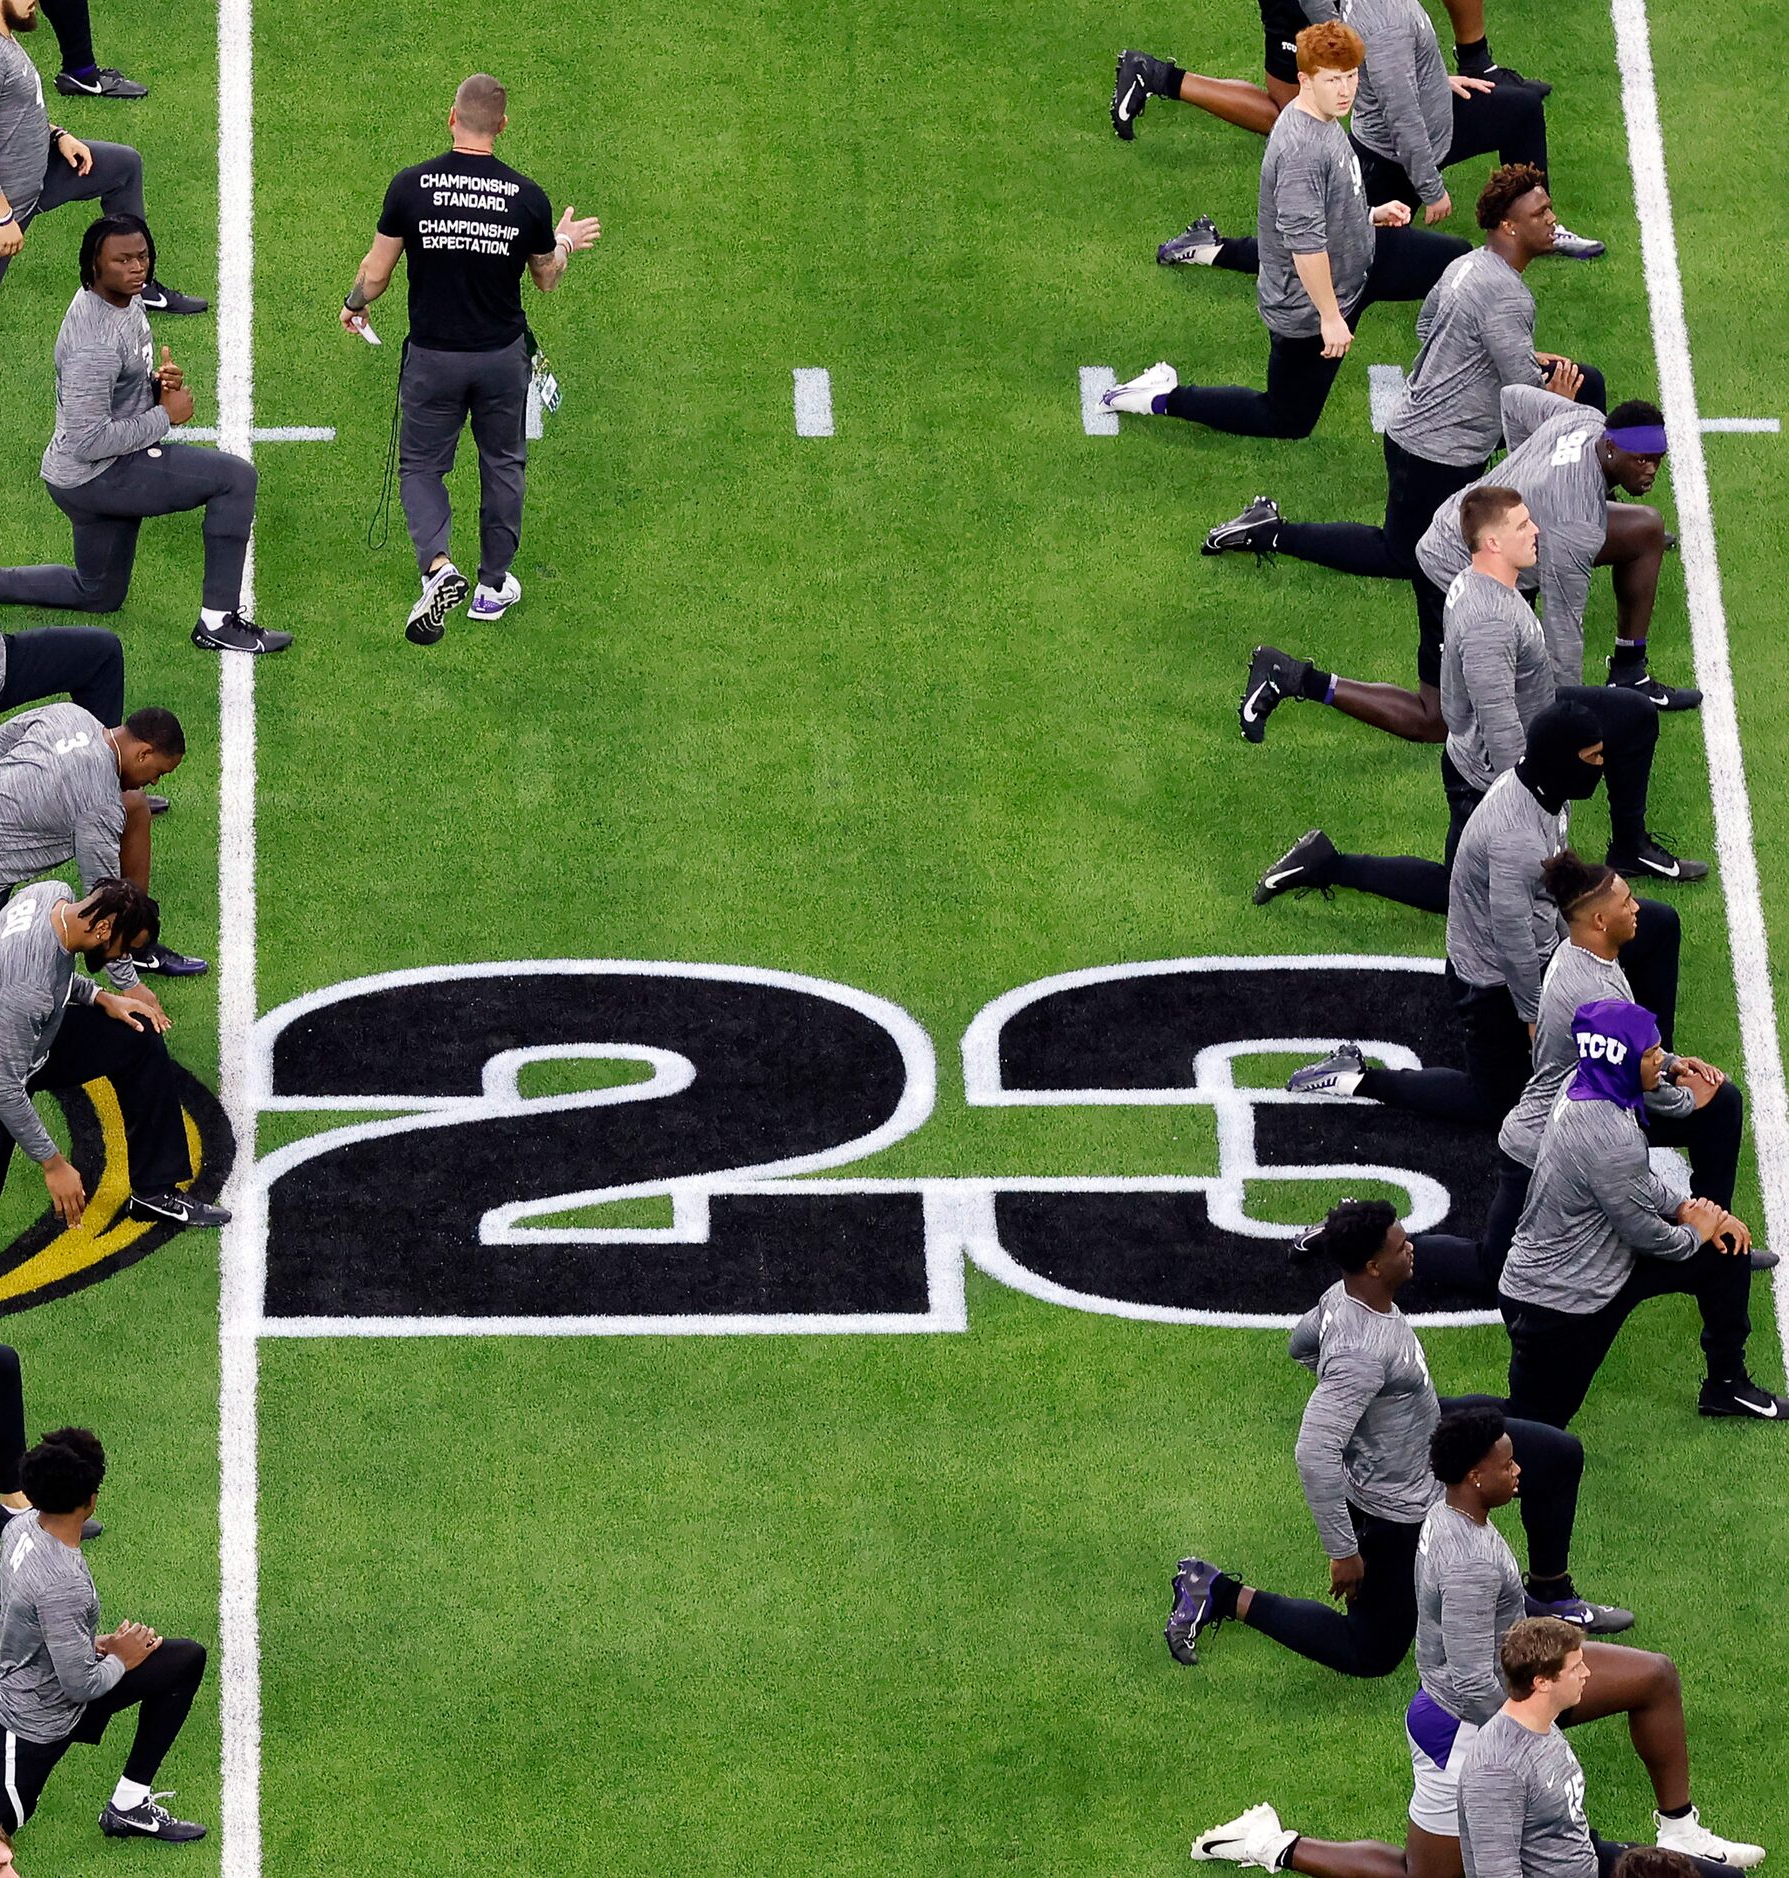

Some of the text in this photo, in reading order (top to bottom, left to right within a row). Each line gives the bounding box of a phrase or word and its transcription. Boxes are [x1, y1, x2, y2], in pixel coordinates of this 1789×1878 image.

[420, 173, 520, 197] CHAMPIONSHIP
[433, 191, 509, 213] STANDARD.
[418, 220, 520, 240] CHAMPIONSHIP
[422, 236, 510, 256] EXPECTATION.
[55, 731, 90, 755] 3
[1575, 1031, 1629, 1066] TCU
